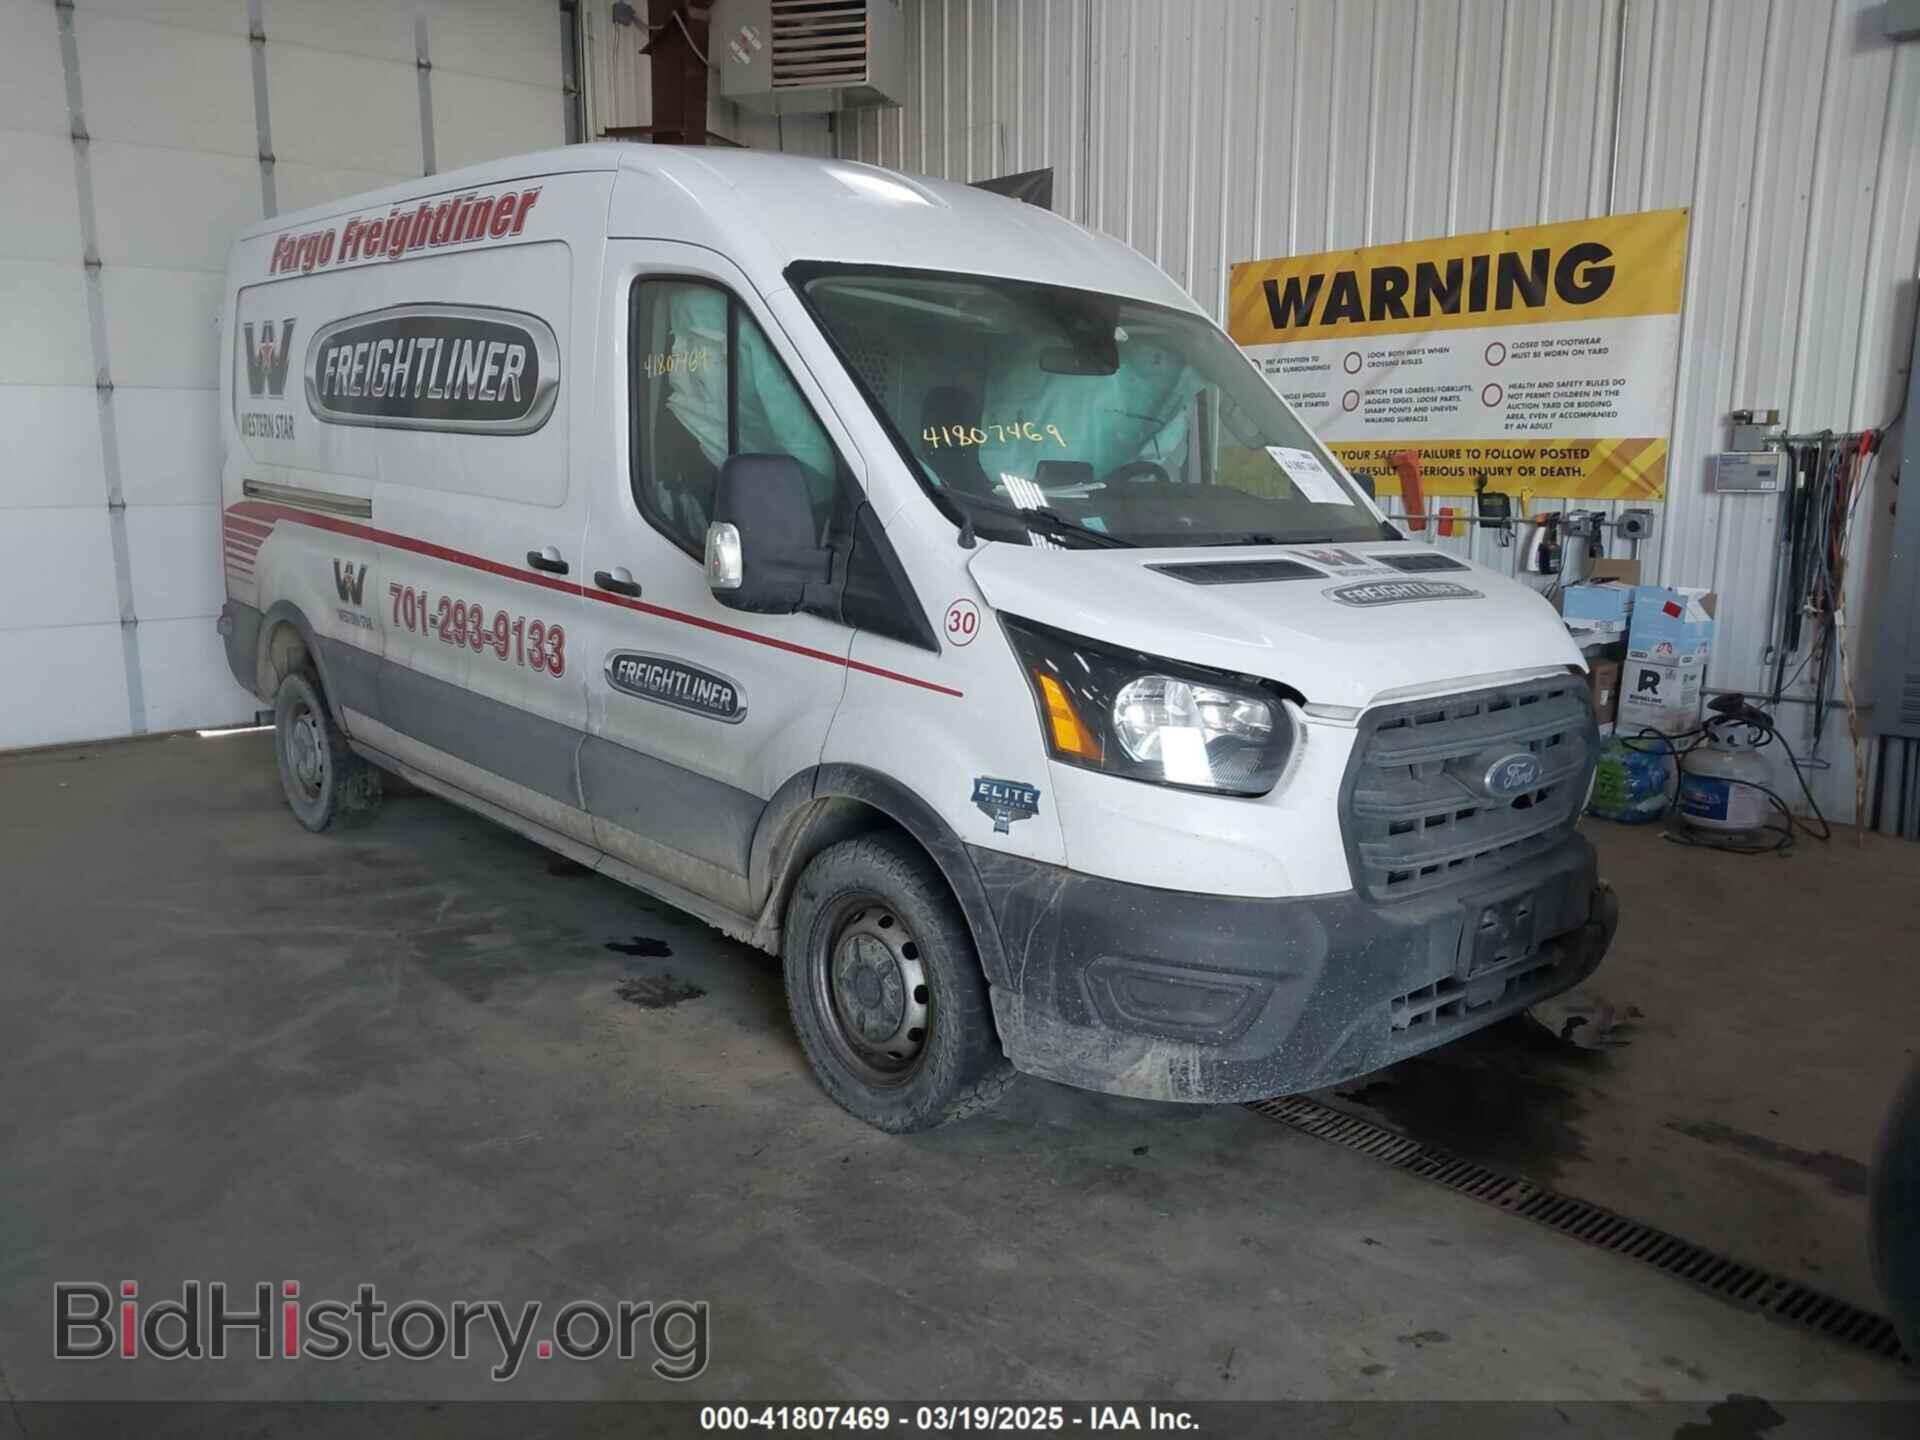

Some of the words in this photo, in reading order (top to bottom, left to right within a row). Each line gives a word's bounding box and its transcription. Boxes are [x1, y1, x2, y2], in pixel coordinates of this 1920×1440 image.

[268, 229, 337, 276] Fargo
[337, 185, 543, 263] Freightliner
[1263, 242, 1616, 330] WARNING
[1512, 341, 1539, 349] CLOSED
[1541, 340, 1554, 348] TOE
[1556, 337, 1602, 347] FOOTWEAR
[1544, 350, 1569, 358] WORN
[1588, 347, 1609, 355] YARD
[321, 337, 526, 403] FREIGHTLINER
[1508, 382, 1536, 390] HEALTH
[1556, 380, 1584, 388] SAFETY
[1586, 379, 1610, 387] RULES
[1612, 378, 1626, 386] DO
[1552, 390, 1590, 399] CHILDREN
[1604, 389, 1620, 397] THE
[1388, 406, 1412, 414] POINTS
[1506, 402, 1539, 410] AUCTION
[1577, 400, 1612, 408] BIDDING
[1529, 412, 1548, 420] EVEN
[1558, 410, 1618, 419] ACCOMPANIED
[275, 413, 295, 441] STAR
[1529, 422, 1553, 430] ADULT
[922, 422, 1067, 449] 41807469
[1342, 450, 1370, 460] YOUR
[1417, 448, 1462, 460] FAILURE
[1466, 448, 1481, 459] TO
[1484, 448, 1536, 460] FOLLOW
[1540, 448, 1590, 460] POSTED
[1468, 466, 1513, 477] INJURY
[1518, 466, 1536, 477] OR
[1540, 466, 1586, 478] DEATH.
[948, 610, 975, 634] 30
[390, 582, 567, 679] 701-293-9133
[607, 660, 732, 711] FREIGHTLINER
[1503, 762, 1535, 789] Ford
[979, 783, 1034, 803] ELITE
